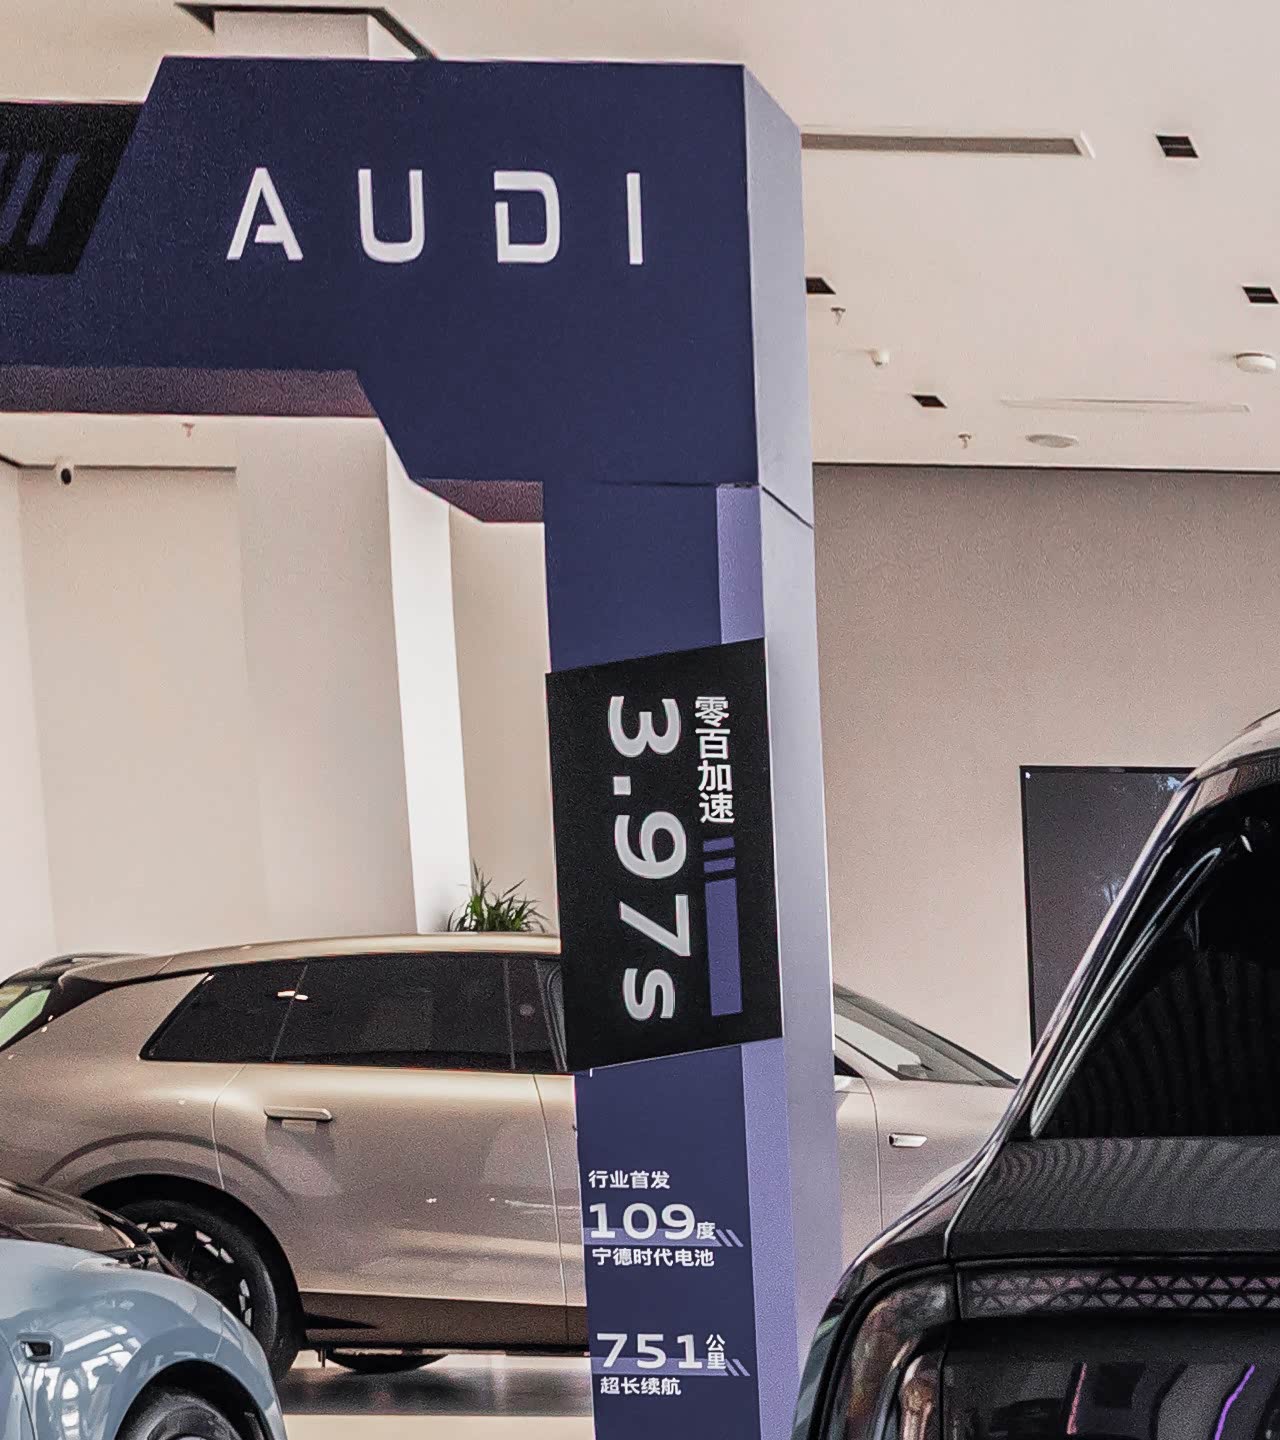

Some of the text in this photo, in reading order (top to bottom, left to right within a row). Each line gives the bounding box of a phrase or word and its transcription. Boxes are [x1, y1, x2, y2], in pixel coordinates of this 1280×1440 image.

[226, 167, 644, 266] AUDI
[695, 696, 735, 824] 零百加速
[588, 1170, 670, 1189] 行业首发
[592, 1248, 715, 1267] 宁德时代电池
[600, 1377, 681, 1396] 超长续航
